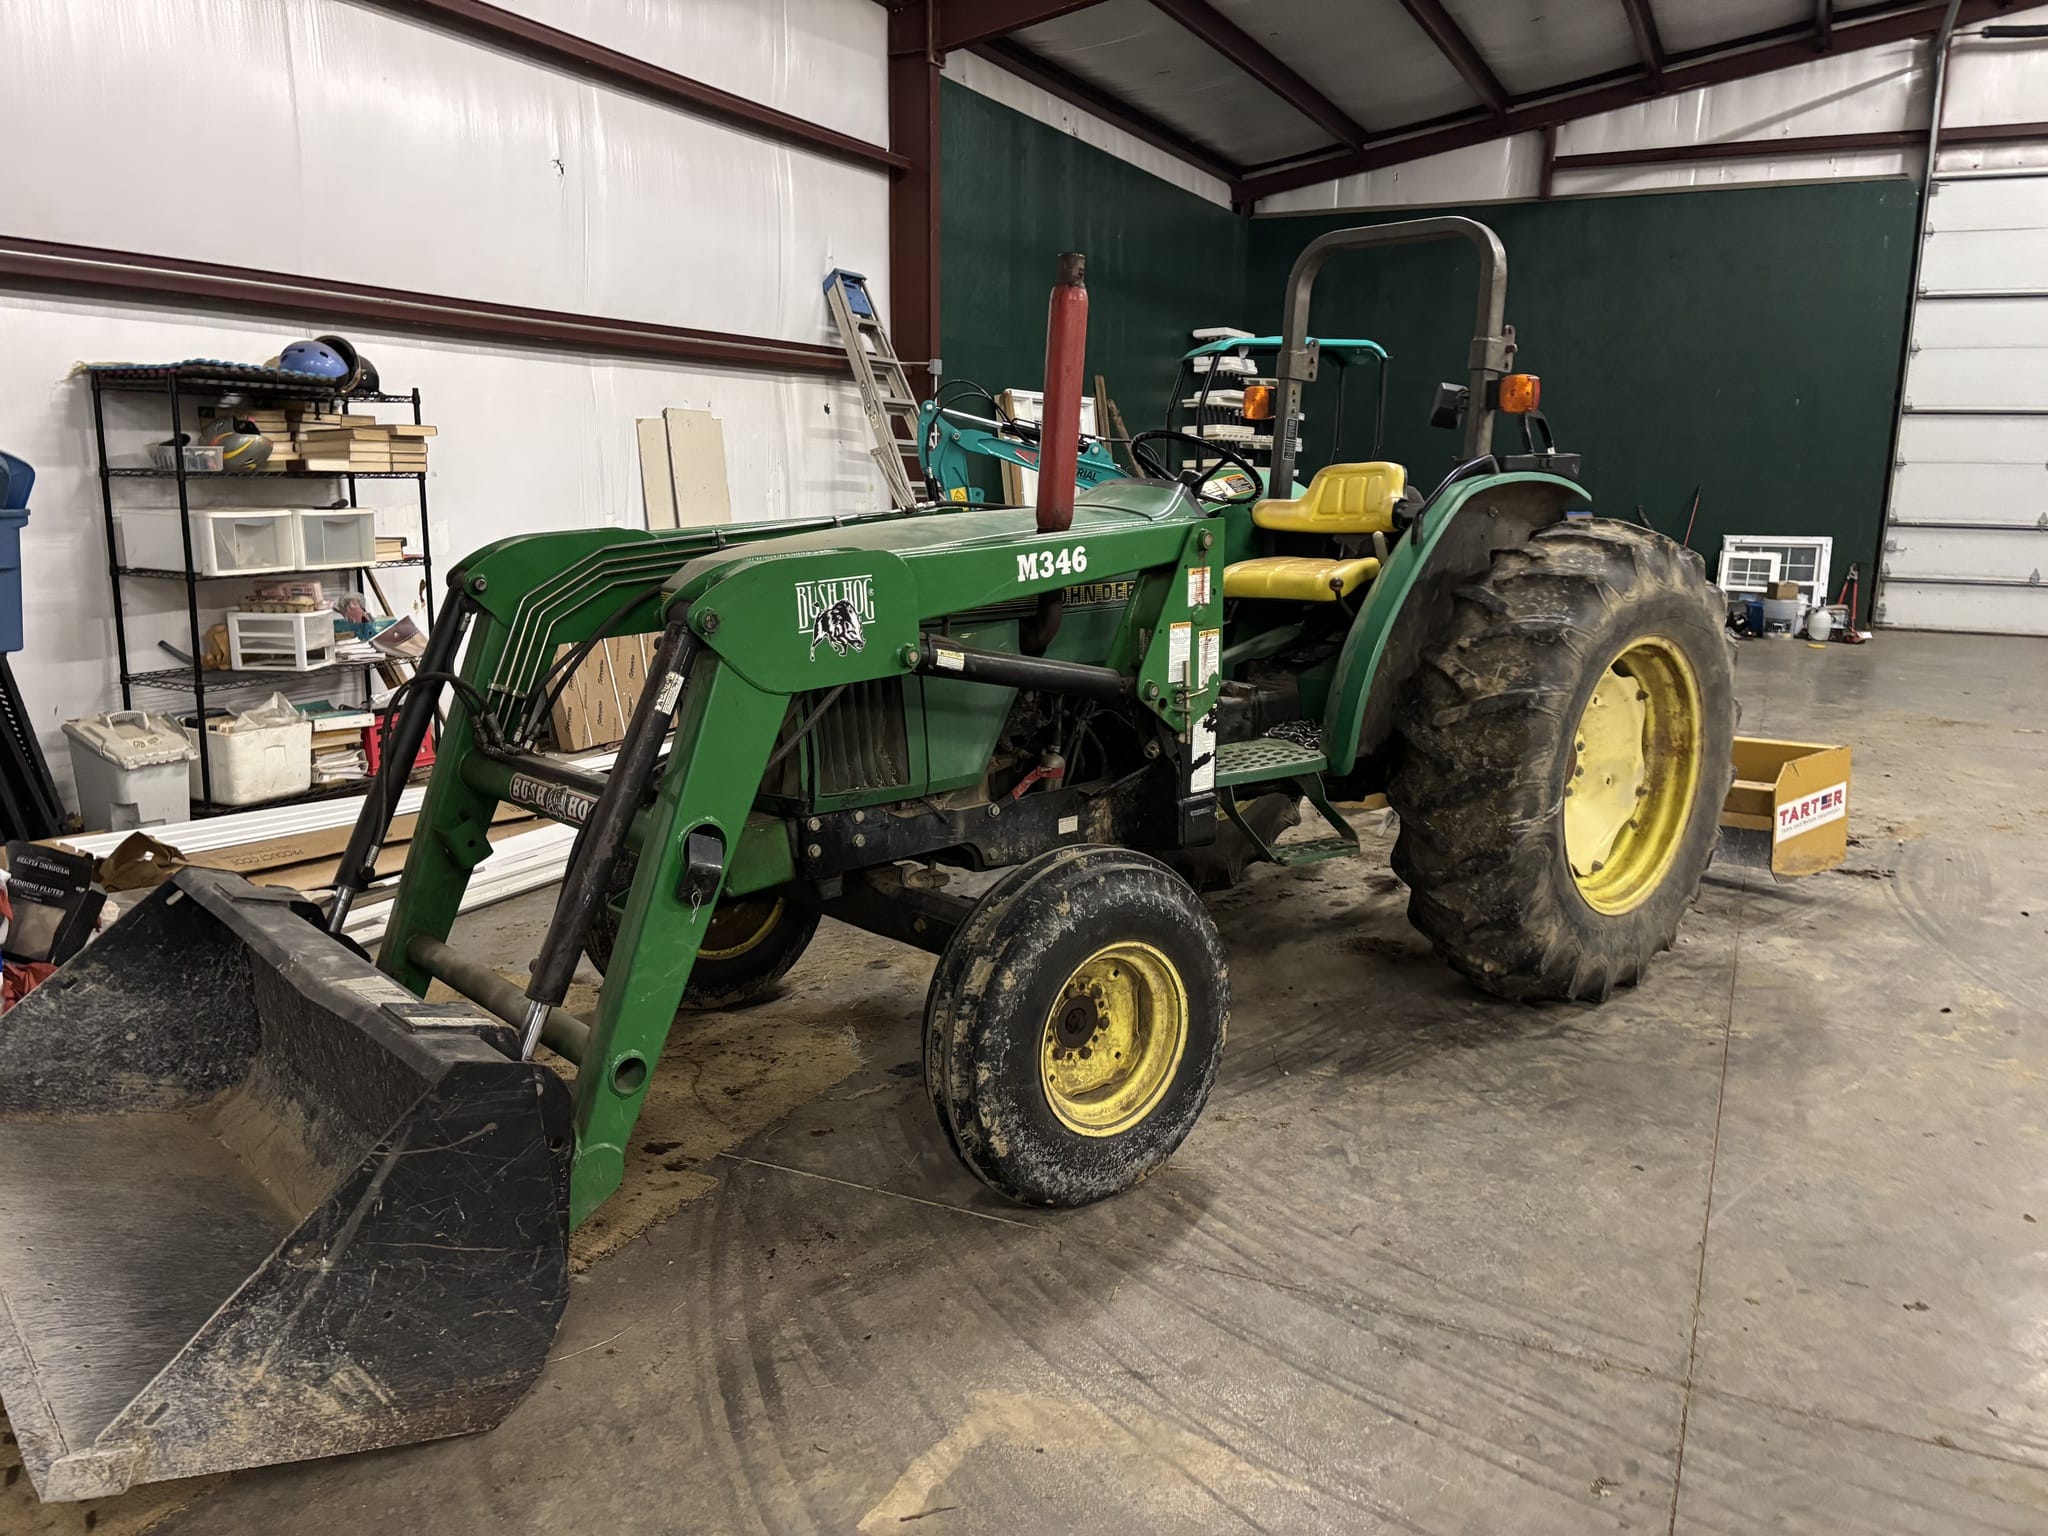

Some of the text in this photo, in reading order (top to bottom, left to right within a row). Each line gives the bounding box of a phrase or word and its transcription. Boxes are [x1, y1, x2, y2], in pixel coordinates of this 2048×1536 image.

[1017, 546, 1087, 582] M346
[796, 577, 875, 629] BUSH HOG
[512, 777, 595, 822] BUSH HO
[1779, 789, 1843, 826] TARTER
[40, 885, 65, 897] FLUTES
